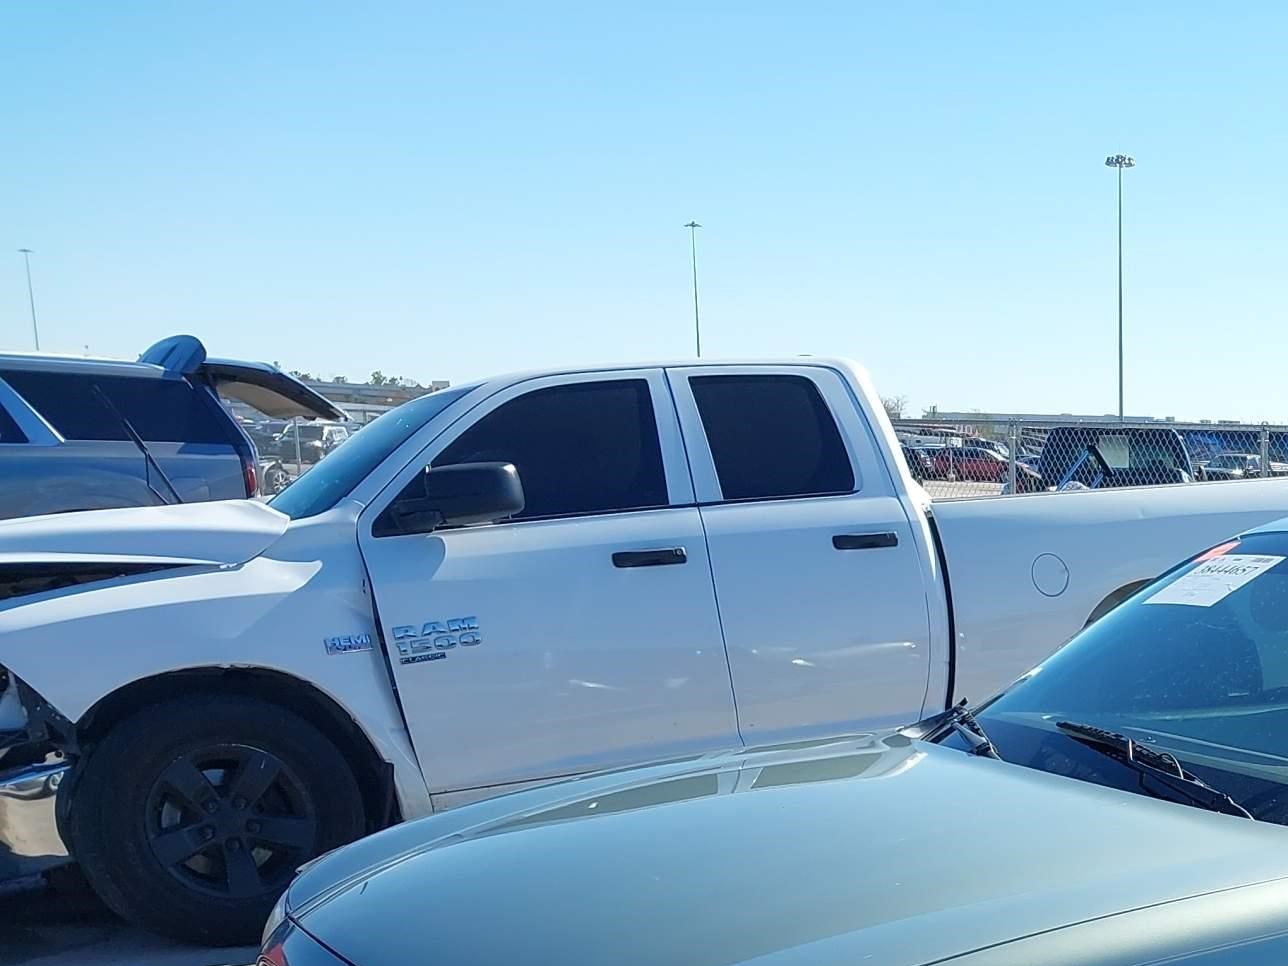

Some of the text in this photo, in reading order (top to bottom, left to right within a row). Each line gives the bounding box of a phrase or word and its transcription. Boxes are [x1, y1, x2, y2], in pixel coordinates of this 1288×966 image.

[392, 616, 480, 640] RAM
[326, 633, 371, 648] HEMI
[396, 631, 482, 656] 1500
